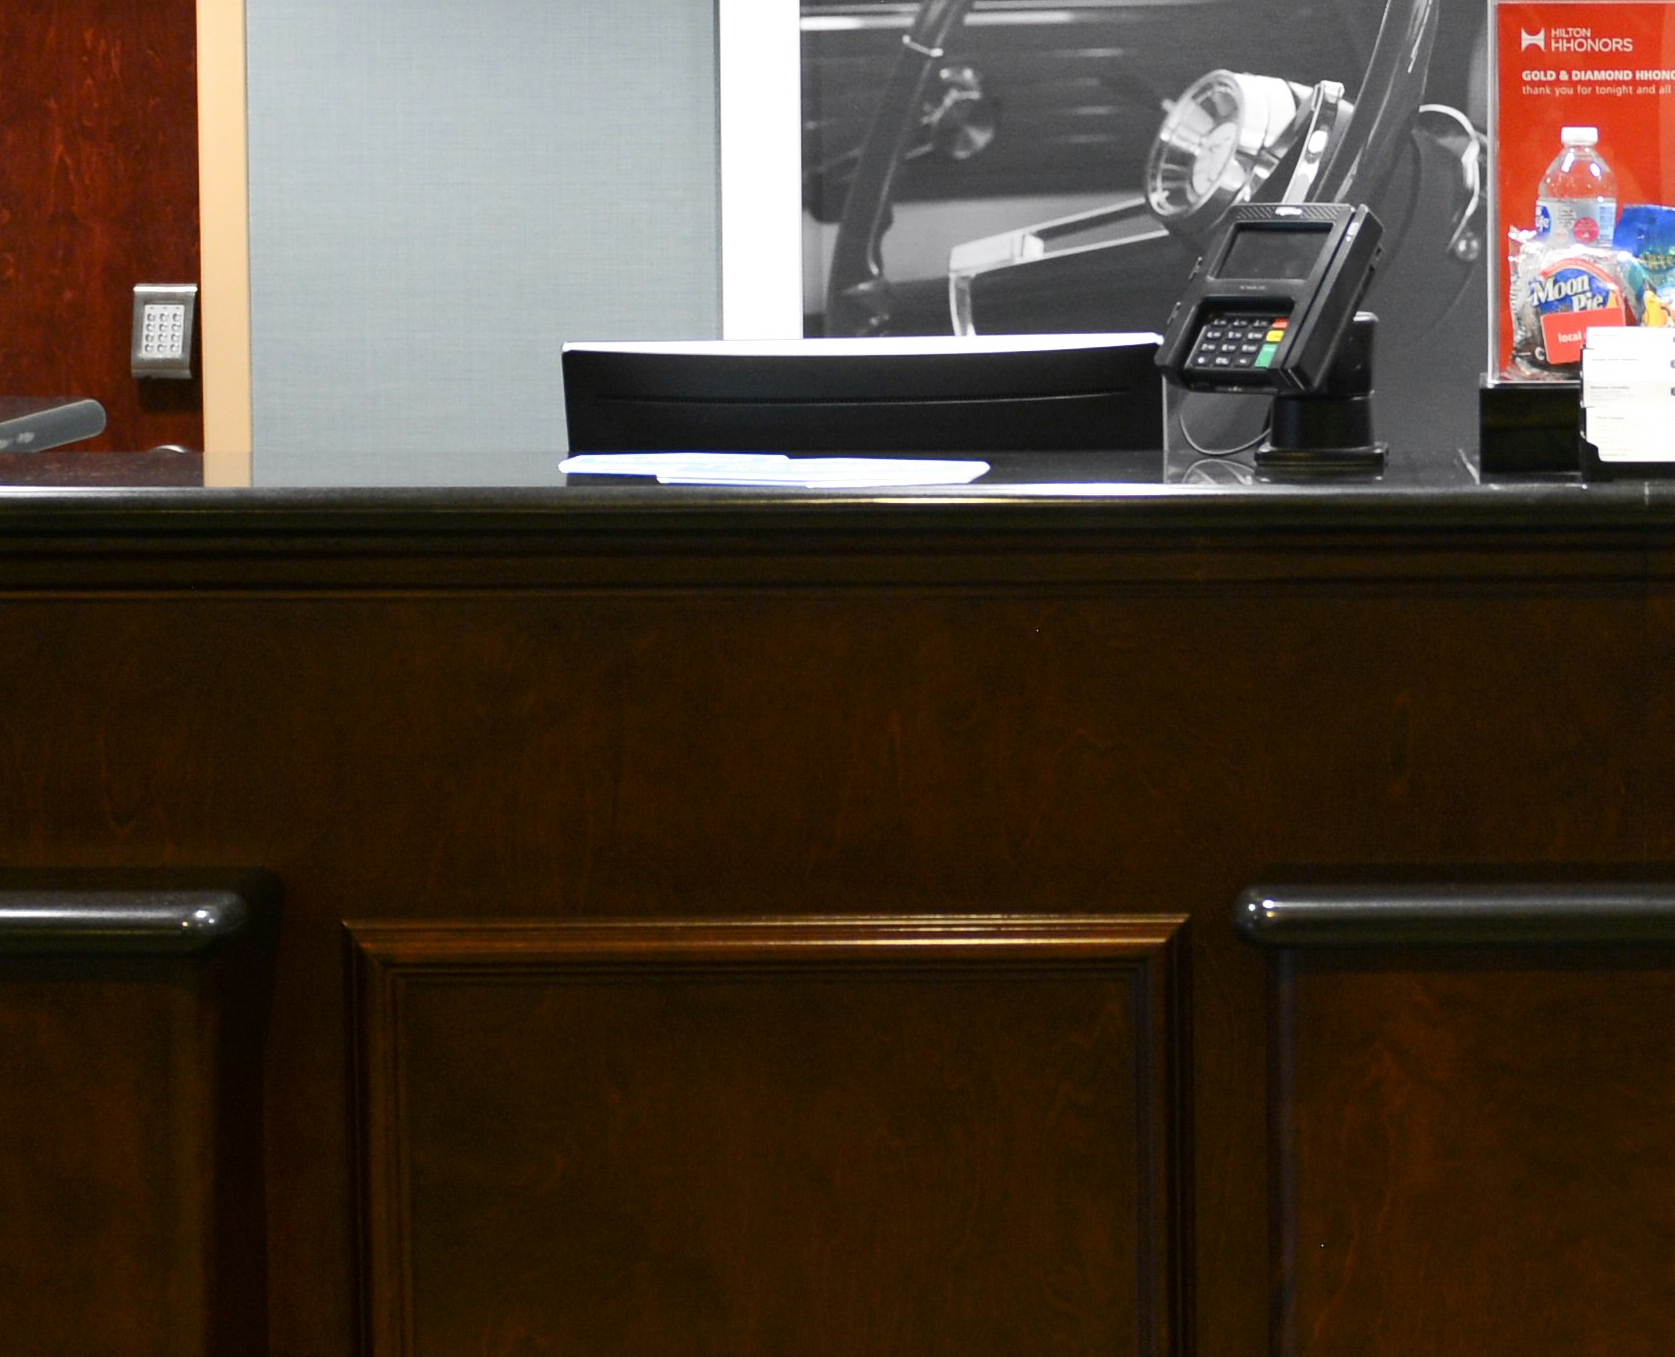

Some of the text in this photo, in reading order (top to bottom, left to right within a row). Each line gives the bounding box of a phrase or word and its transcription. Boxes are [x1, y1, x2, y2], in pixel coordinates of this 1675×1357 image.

[1551, 27, 1591, 38] HILTON
[1551, 38, 1634, 52] HHONORS
[1522, 70, 1557, 81] GOLD
[1559, 70, 1569, 81] &
[1571, 70, 1633, 81] DIAMOND
[1522, 85, 1551, 95] thank
[1554, 87, 1574, 97] you
[1577, 85, 1592, 95] for
[1595, 85, 1633, 97] tonight
[1636, 85, 1656, 95] and
[1658, 84, 1672, 95] all
[1531, 274, 1591, 307] Moon
[1572, 291, 1604, 312] Pie
[1557, 330, 1583, 344] local
